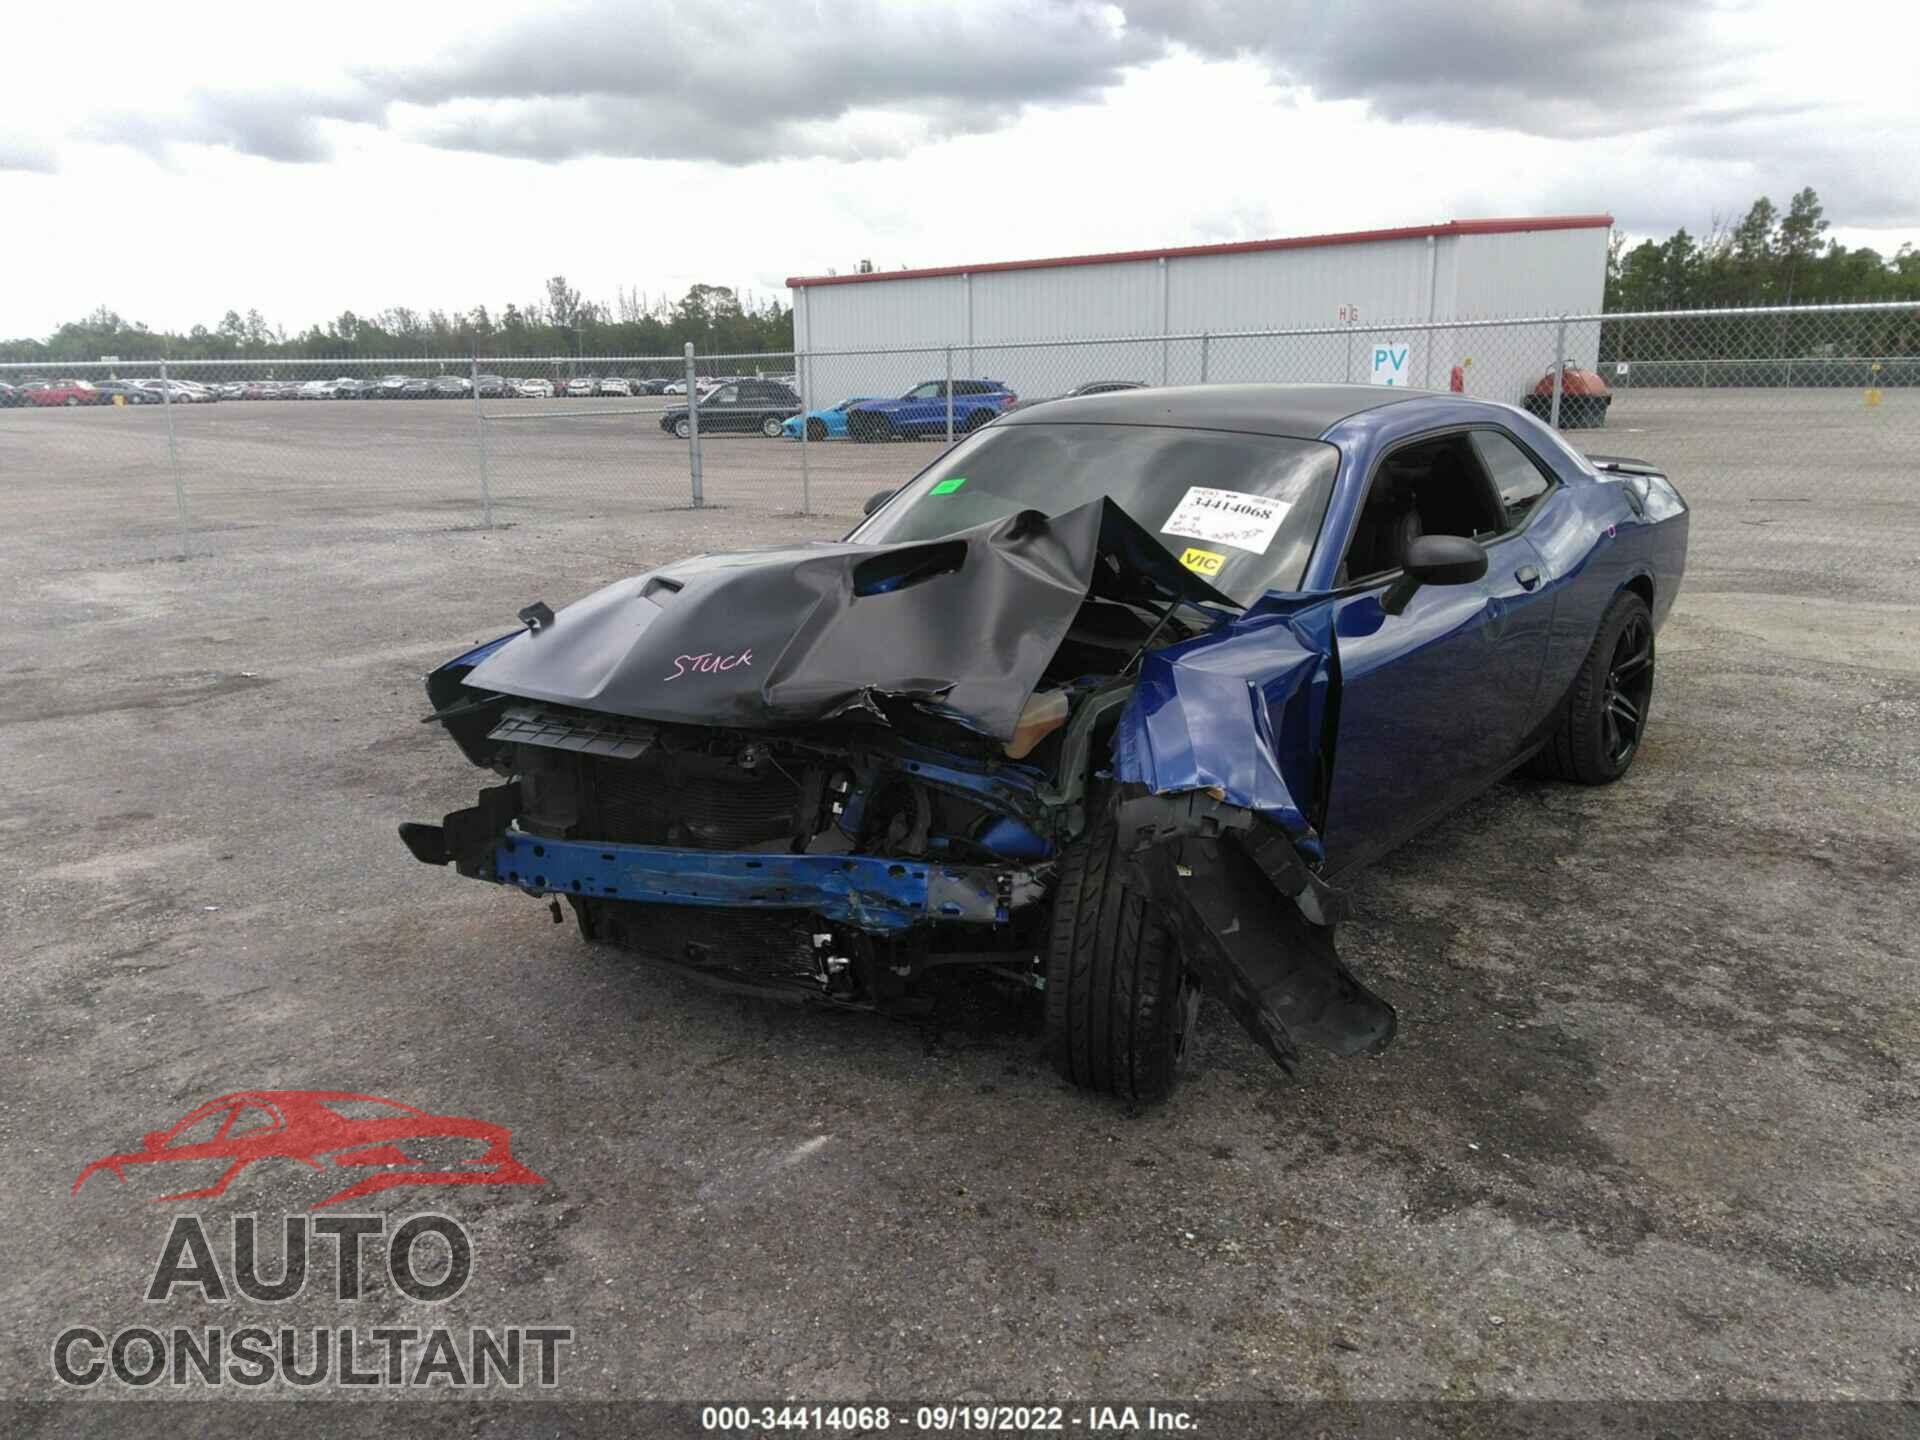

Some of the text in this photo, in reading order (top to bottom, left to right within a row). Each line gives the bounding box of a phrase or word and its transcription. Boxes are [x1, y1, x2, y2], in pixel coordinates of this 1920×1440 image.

[1375, 349, 1407, 371] PV
[1191, 497, 1273, 520] 34414068
[1185, 552, 1218, 570] VIC
[663, 648, 752, 681] STUCK
